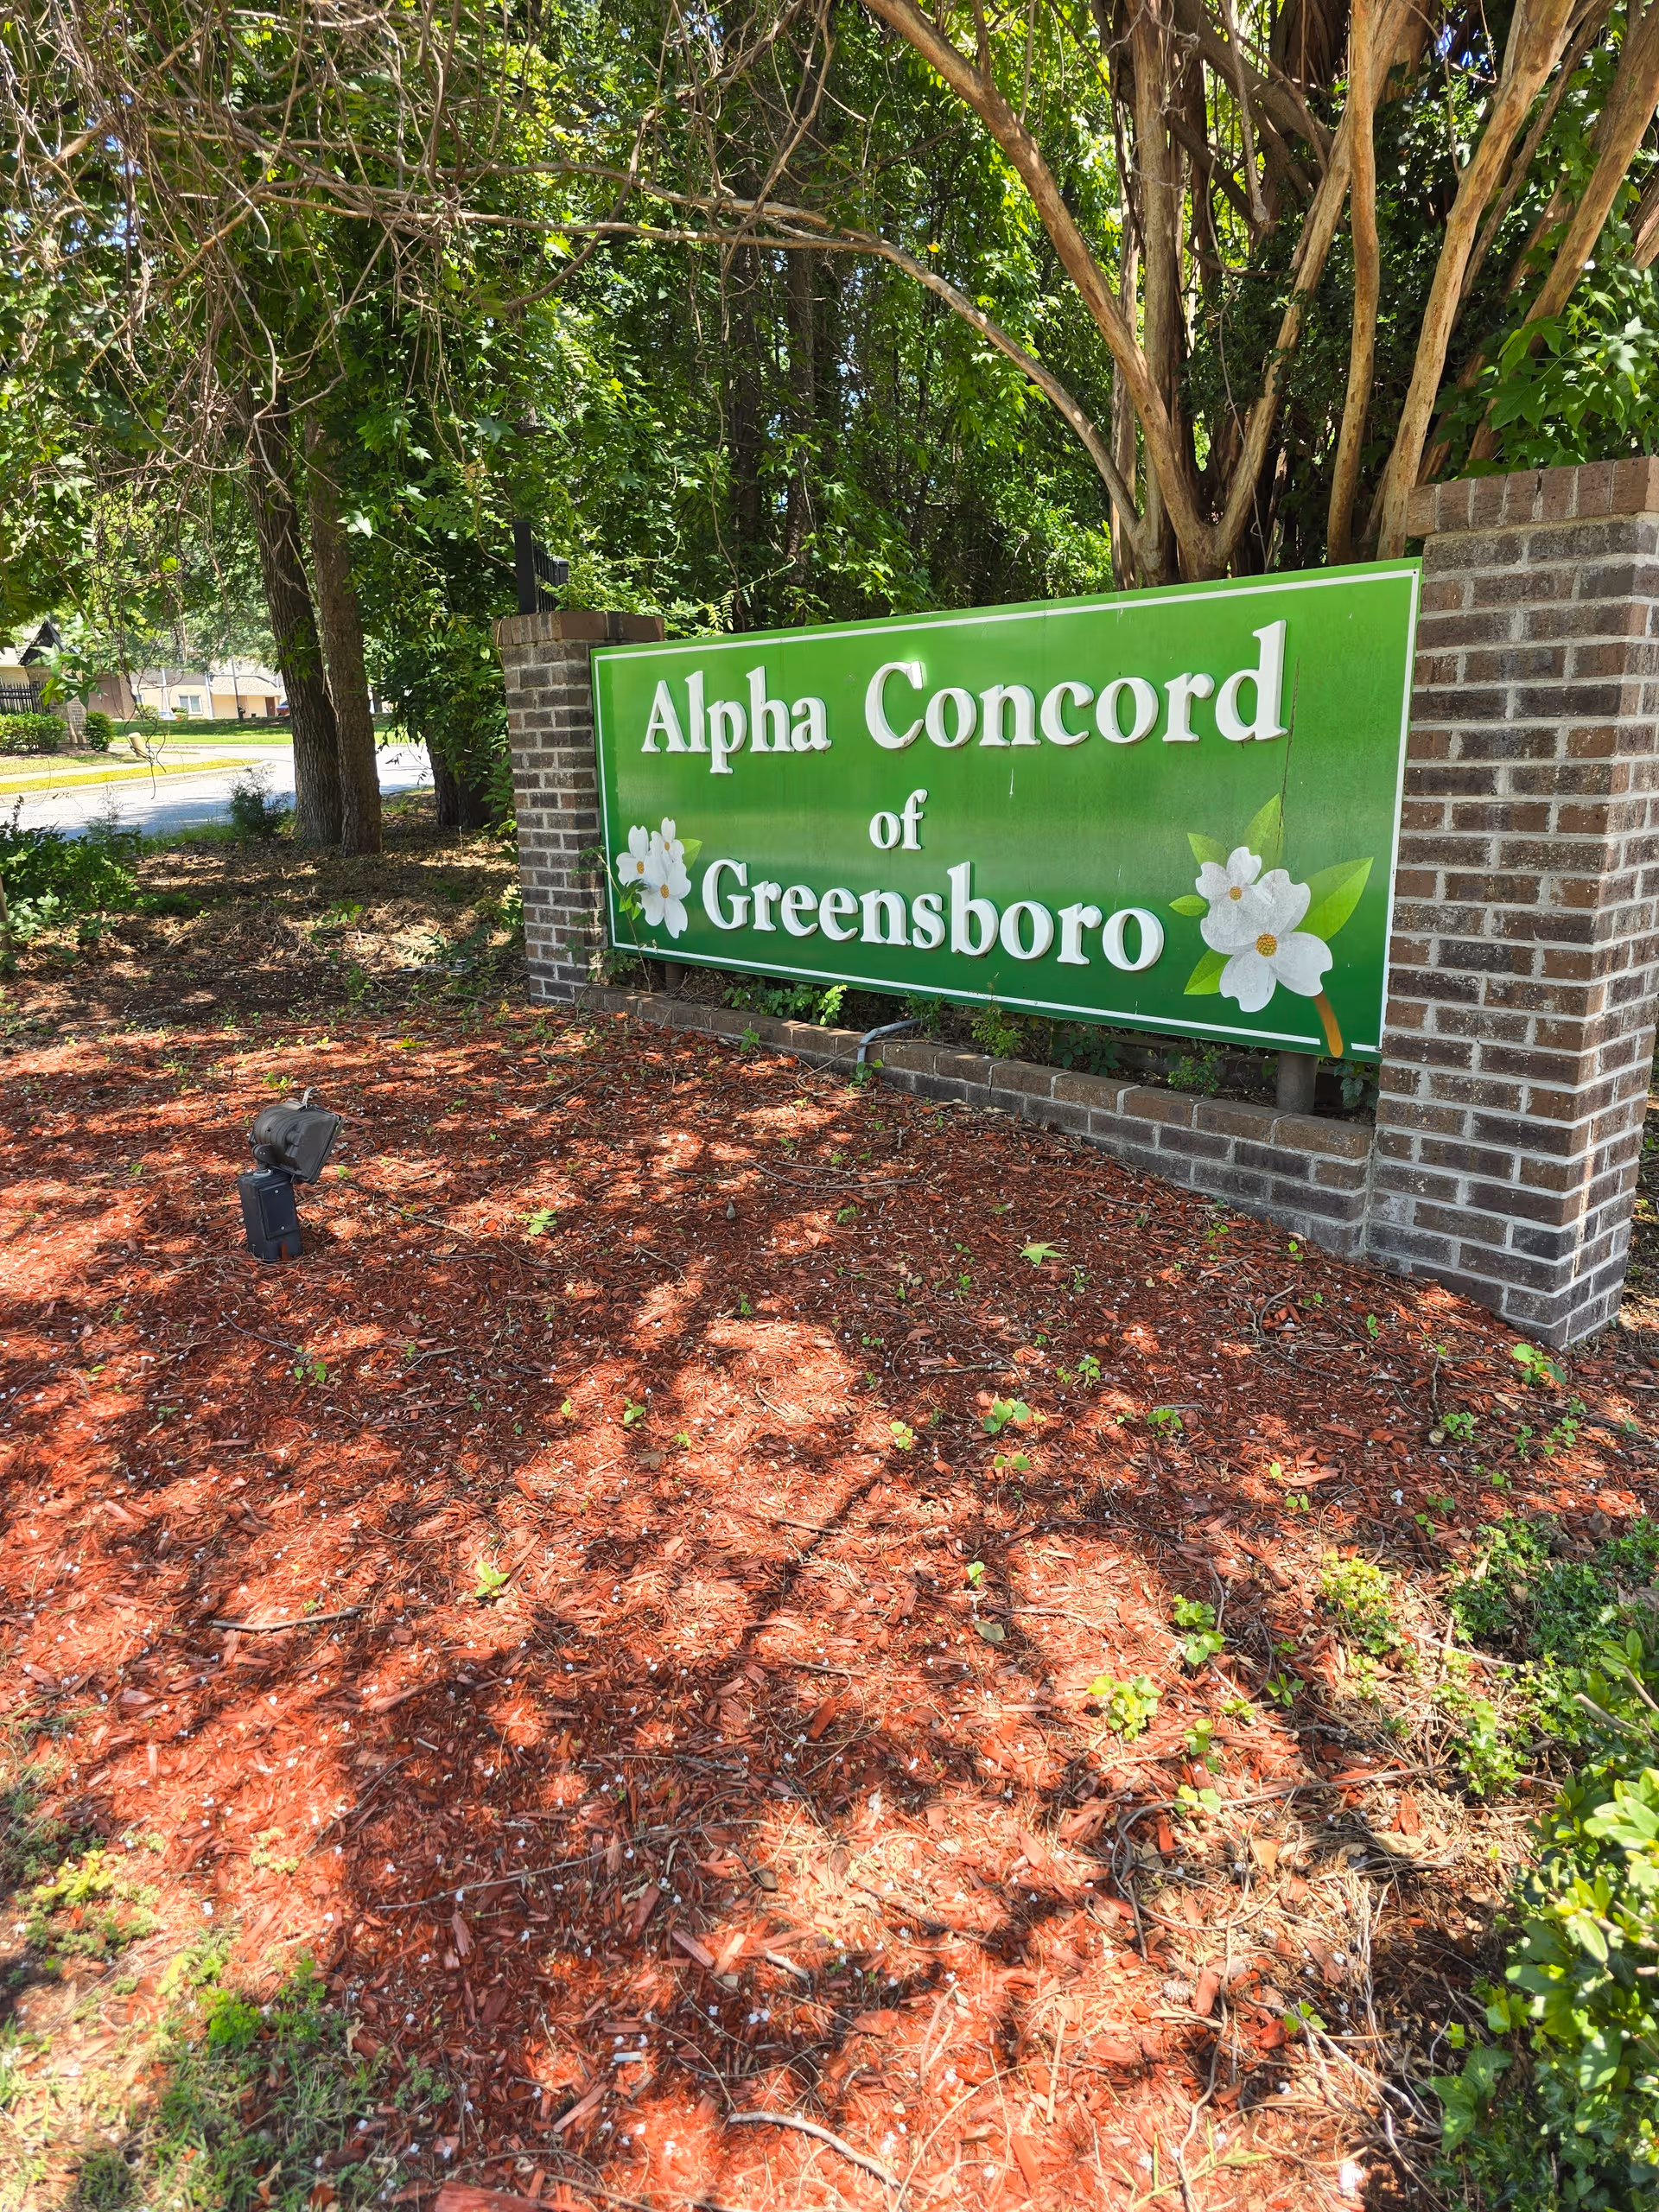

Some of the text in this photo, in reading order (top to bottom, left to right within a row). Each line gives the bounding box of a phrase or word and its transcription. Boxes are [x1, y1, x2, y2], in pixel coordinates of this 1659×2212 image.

[641, 620, 1287, 774] Alpha Concord
[869, 789, 928, 851] of
[701, 858, 1165, 972] Greensboro
